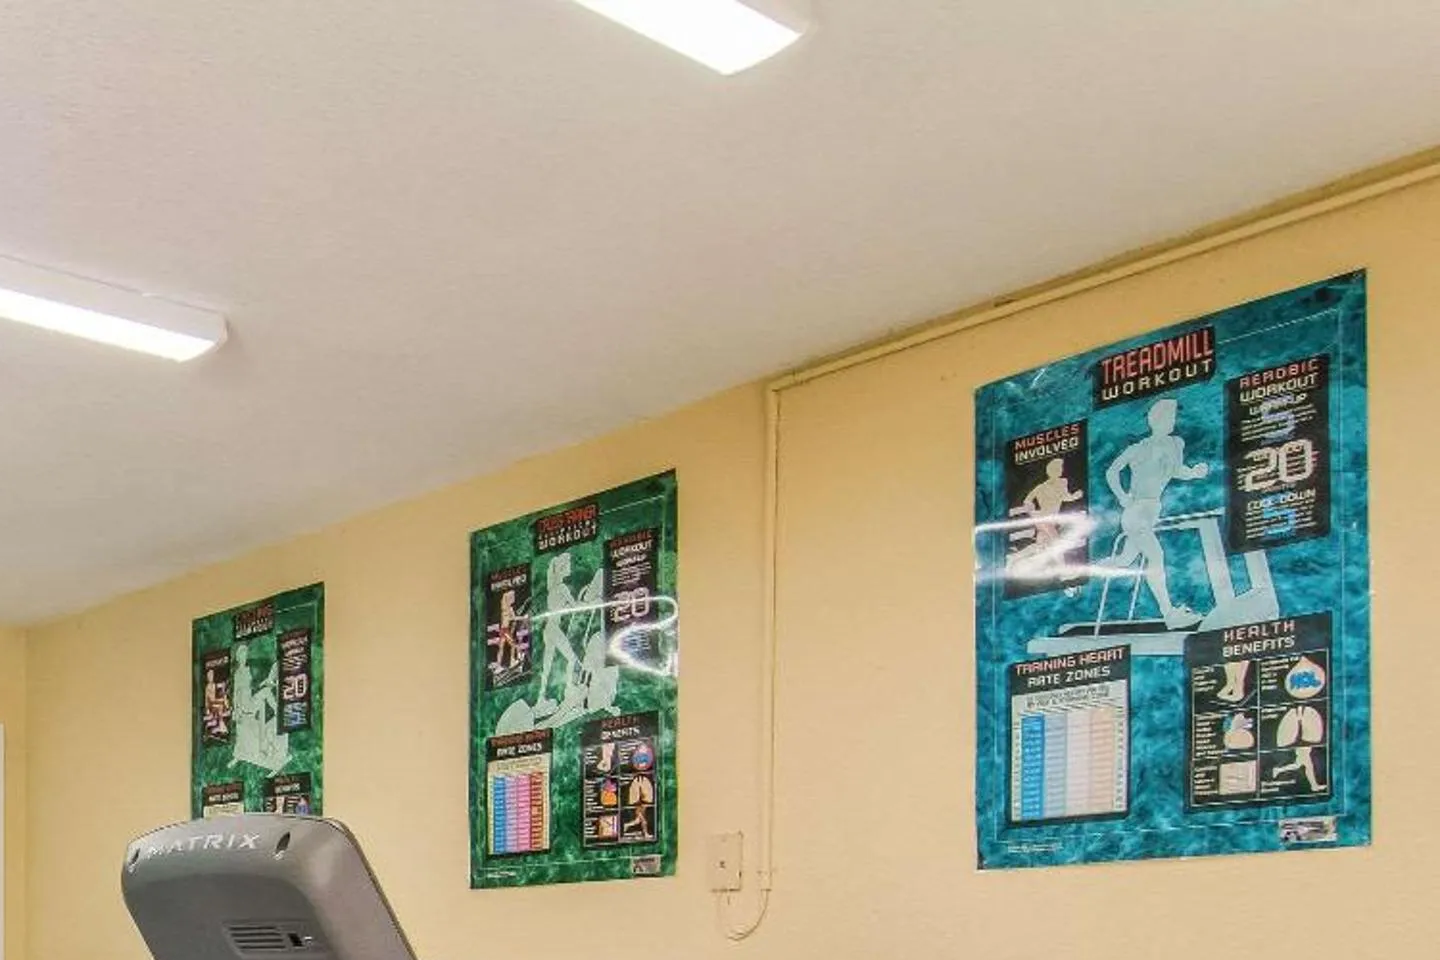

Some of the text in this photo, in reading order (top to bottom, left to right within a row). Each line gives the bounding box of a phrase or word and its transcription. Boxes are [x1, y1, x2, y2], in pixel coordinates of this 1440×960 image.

[1101, 329, 1213, 385] TREADMILL
[1102, 358, 1212, 400] WORKOUT
[1240, 358, 1319, 390] AEROBIC
[1240, 372, 1318, 402] WORKOUT
[1014, 423, 1080, 450] MUSCLES
[1014, 436, 1079, 463] INVOLVED
[1244, 439, 1313, 492] 20
[1224, 619, 1295, 642] HEALTH
[1222, 635, 1296, 658] BENEFITS
[1016, 647, 1124, 676] TRAINING HEART
[1027, 665, 1111, 688] RATE ZONES
[144, 834, 260, 860] MATRIX
